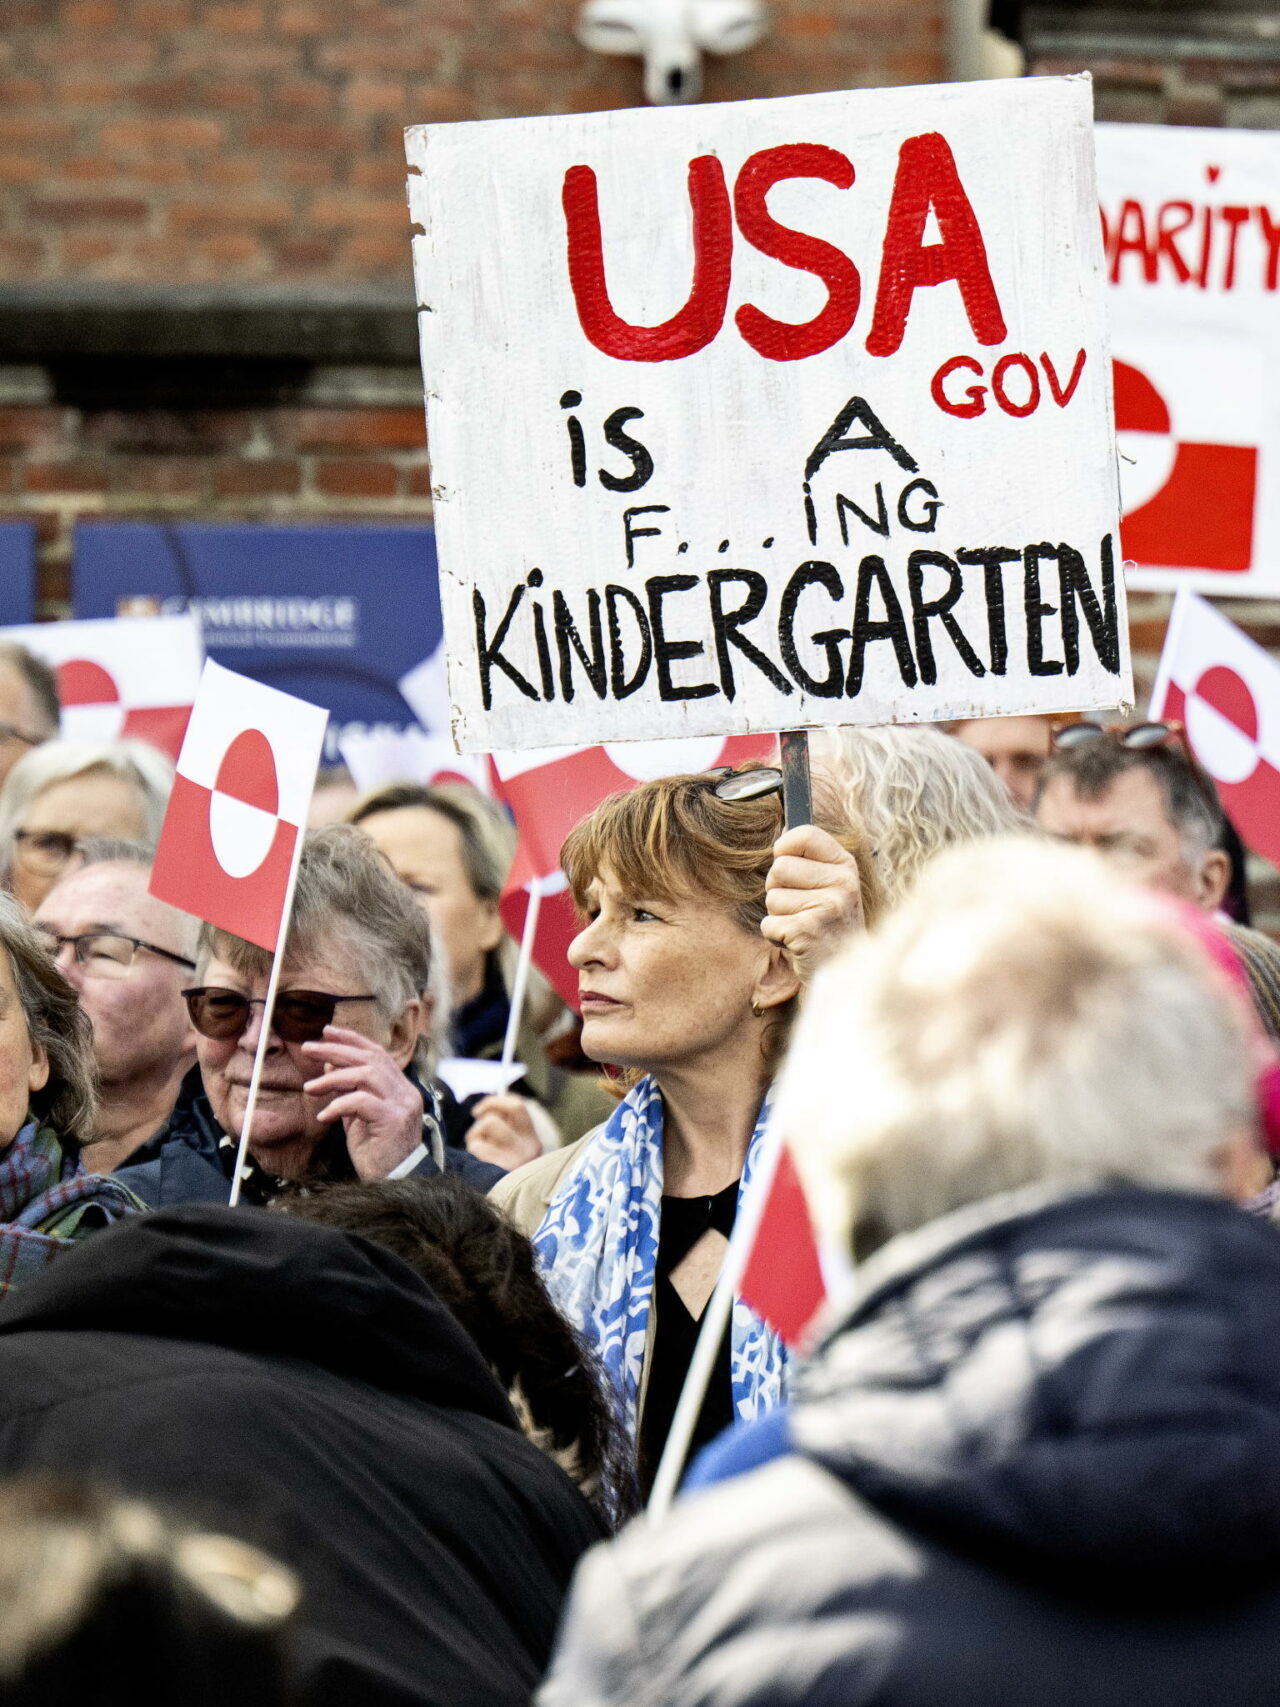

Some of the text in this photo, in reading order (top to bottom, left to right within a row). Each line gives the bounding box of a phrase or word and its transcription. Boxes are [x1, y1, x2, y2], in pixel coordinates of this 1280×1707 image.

[562, 131, 1009, 363] USA
[930, 348, 1088, 419] GOV
[804, 396, 921, 482] A
